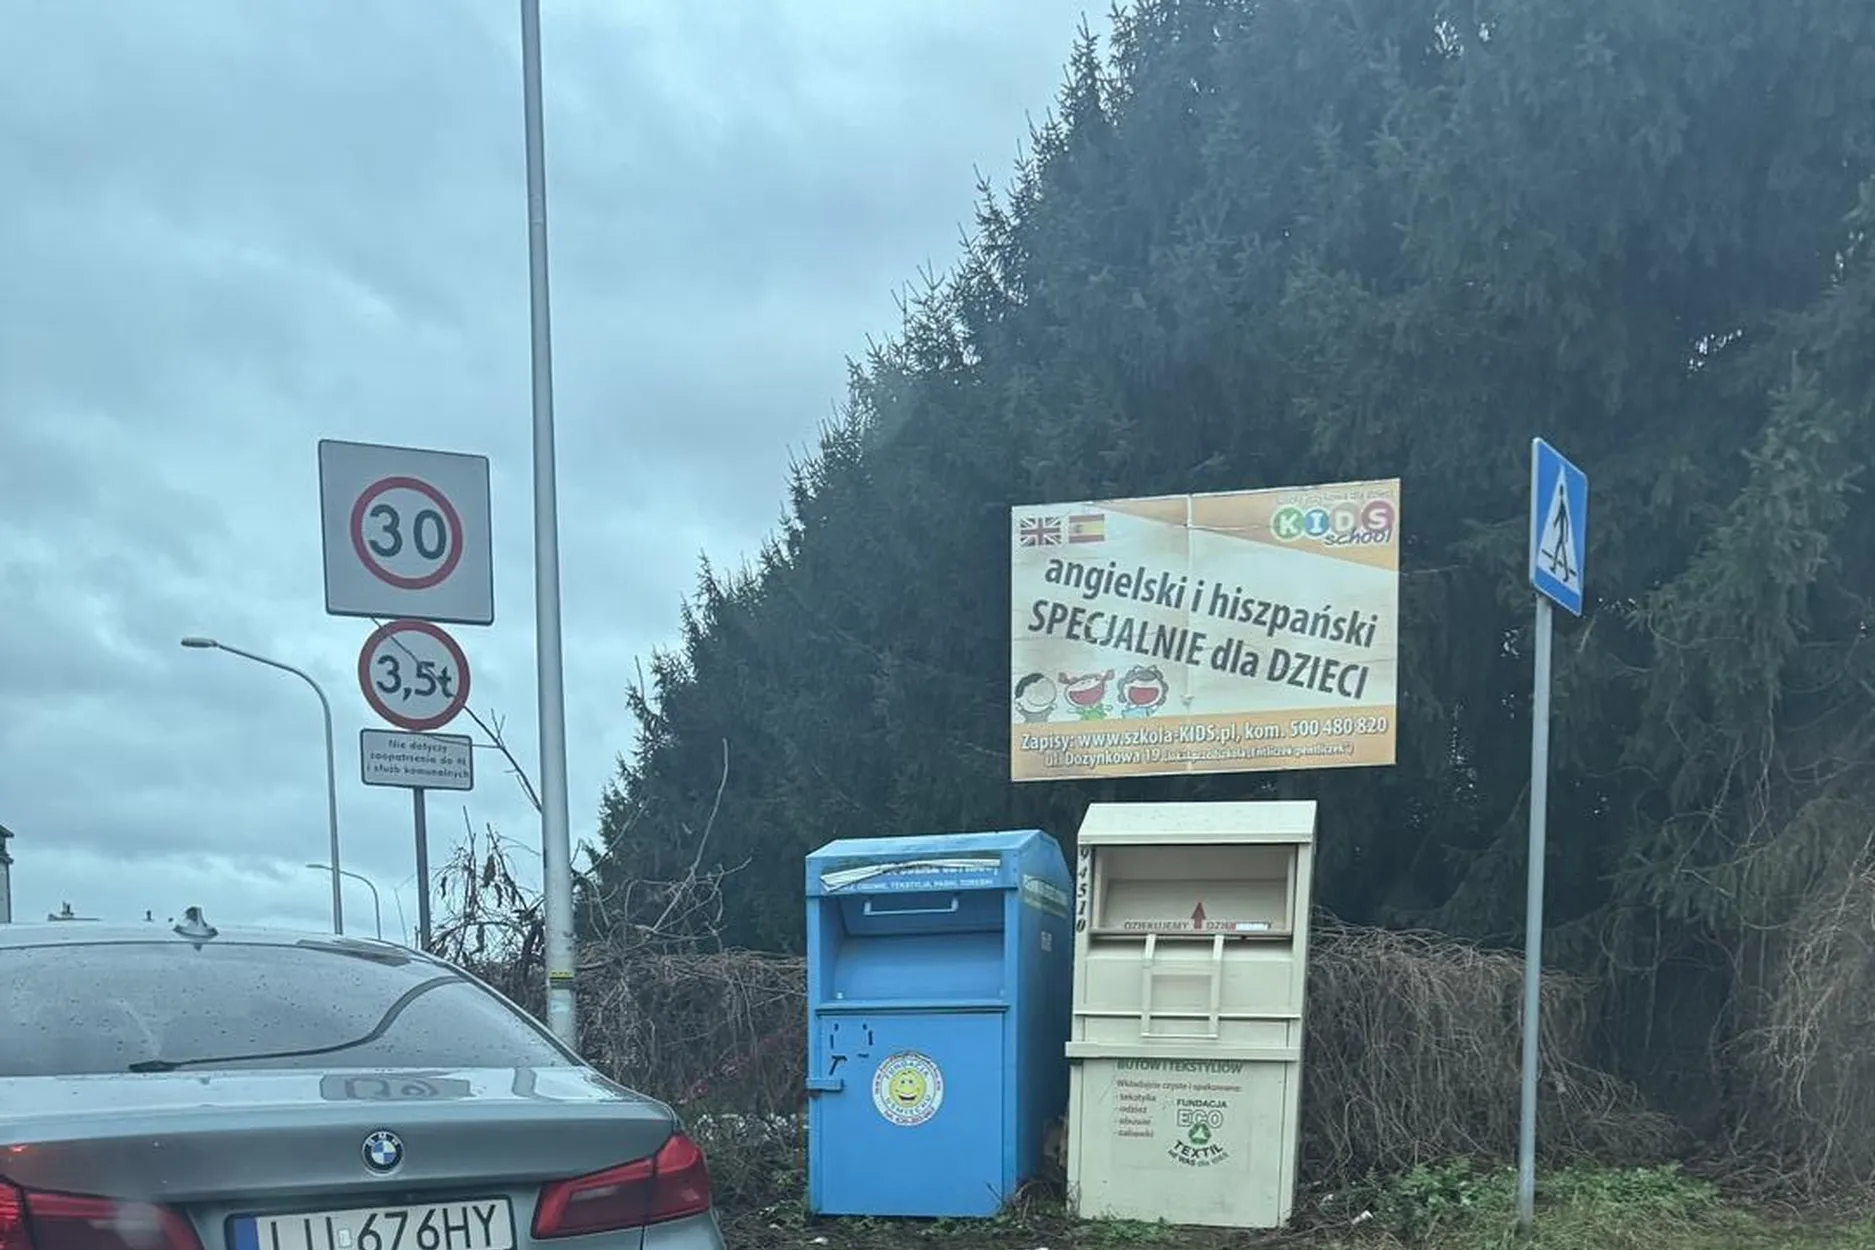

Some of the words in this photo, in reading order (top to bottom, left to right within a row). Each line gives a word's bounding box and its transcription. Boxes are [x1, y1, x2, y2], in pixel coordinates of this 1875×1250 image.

[368, 503, 447, 561] 30
[1274, 503, 1392, 537] KIDS
[1324, 528, 1392, 545] school
[1045, 557, 1188, 609] angielski
[1191, 580, 1204, 612] i
[1208, 582, 1379, 648] hiszpański
[1028, 599, 1207, 666] SPECJALNIE
[1210, 638, 1260, 678] dla
[1266, 648, 1370, 699] DZIECI
[376, 655, 452, 701] 3,5t
[1021, 733, 1075, 752] Zapisy:
[1245, 724, 1286, 741] kom.
[1291, 719, 1319, 736] 500
[1323, 718, 1353, 735] 480
[1357, 716, 1388, 733] 820
[1176, 1098, 1228, 1108] FUNDACJA
[1176, 1108, 1224, 1128] ECO
[1174, 1140, 1224, 1159] TEXTIL
